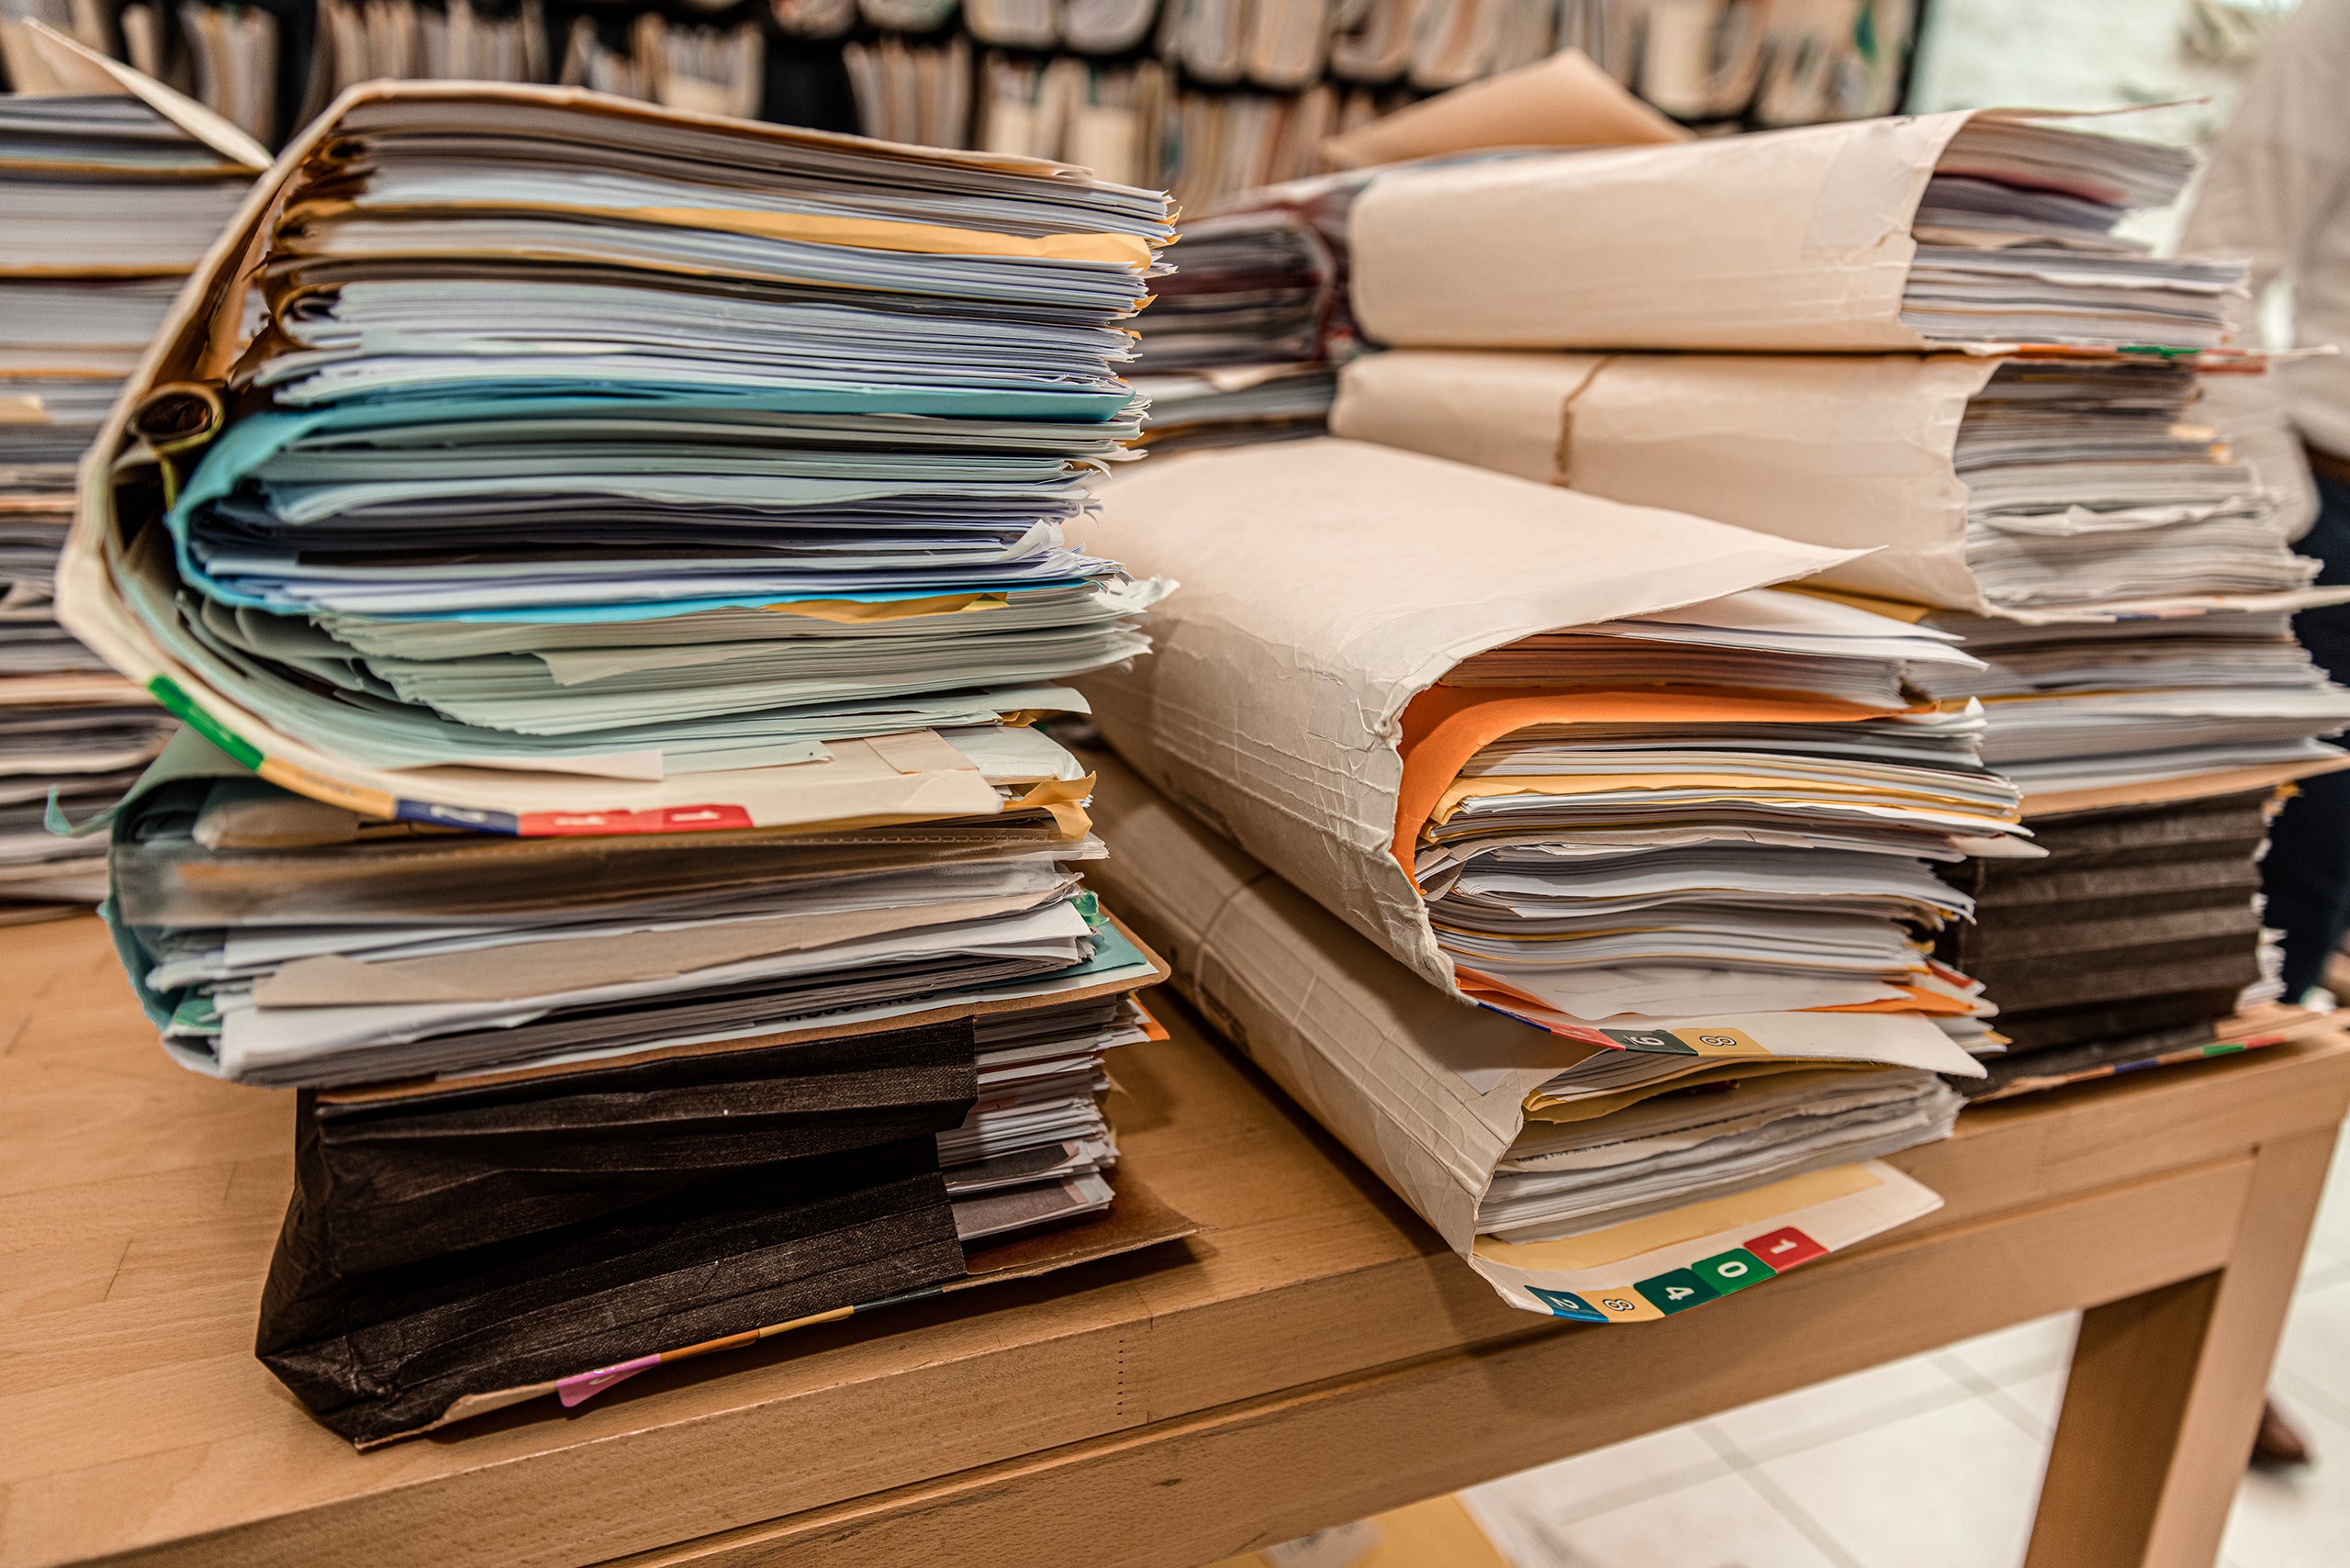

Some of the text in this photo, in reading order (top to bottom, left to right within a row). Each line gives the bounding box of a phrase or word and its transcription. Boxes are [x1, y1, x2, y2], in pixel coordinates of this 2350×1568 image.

[554, 814, 606, 826] 1
[670, 809, 722, 822] 1
[1699, 1035, 1738, 1046] 8
[1548, 1238, 1798, 1311] 1 0 4 8 2
